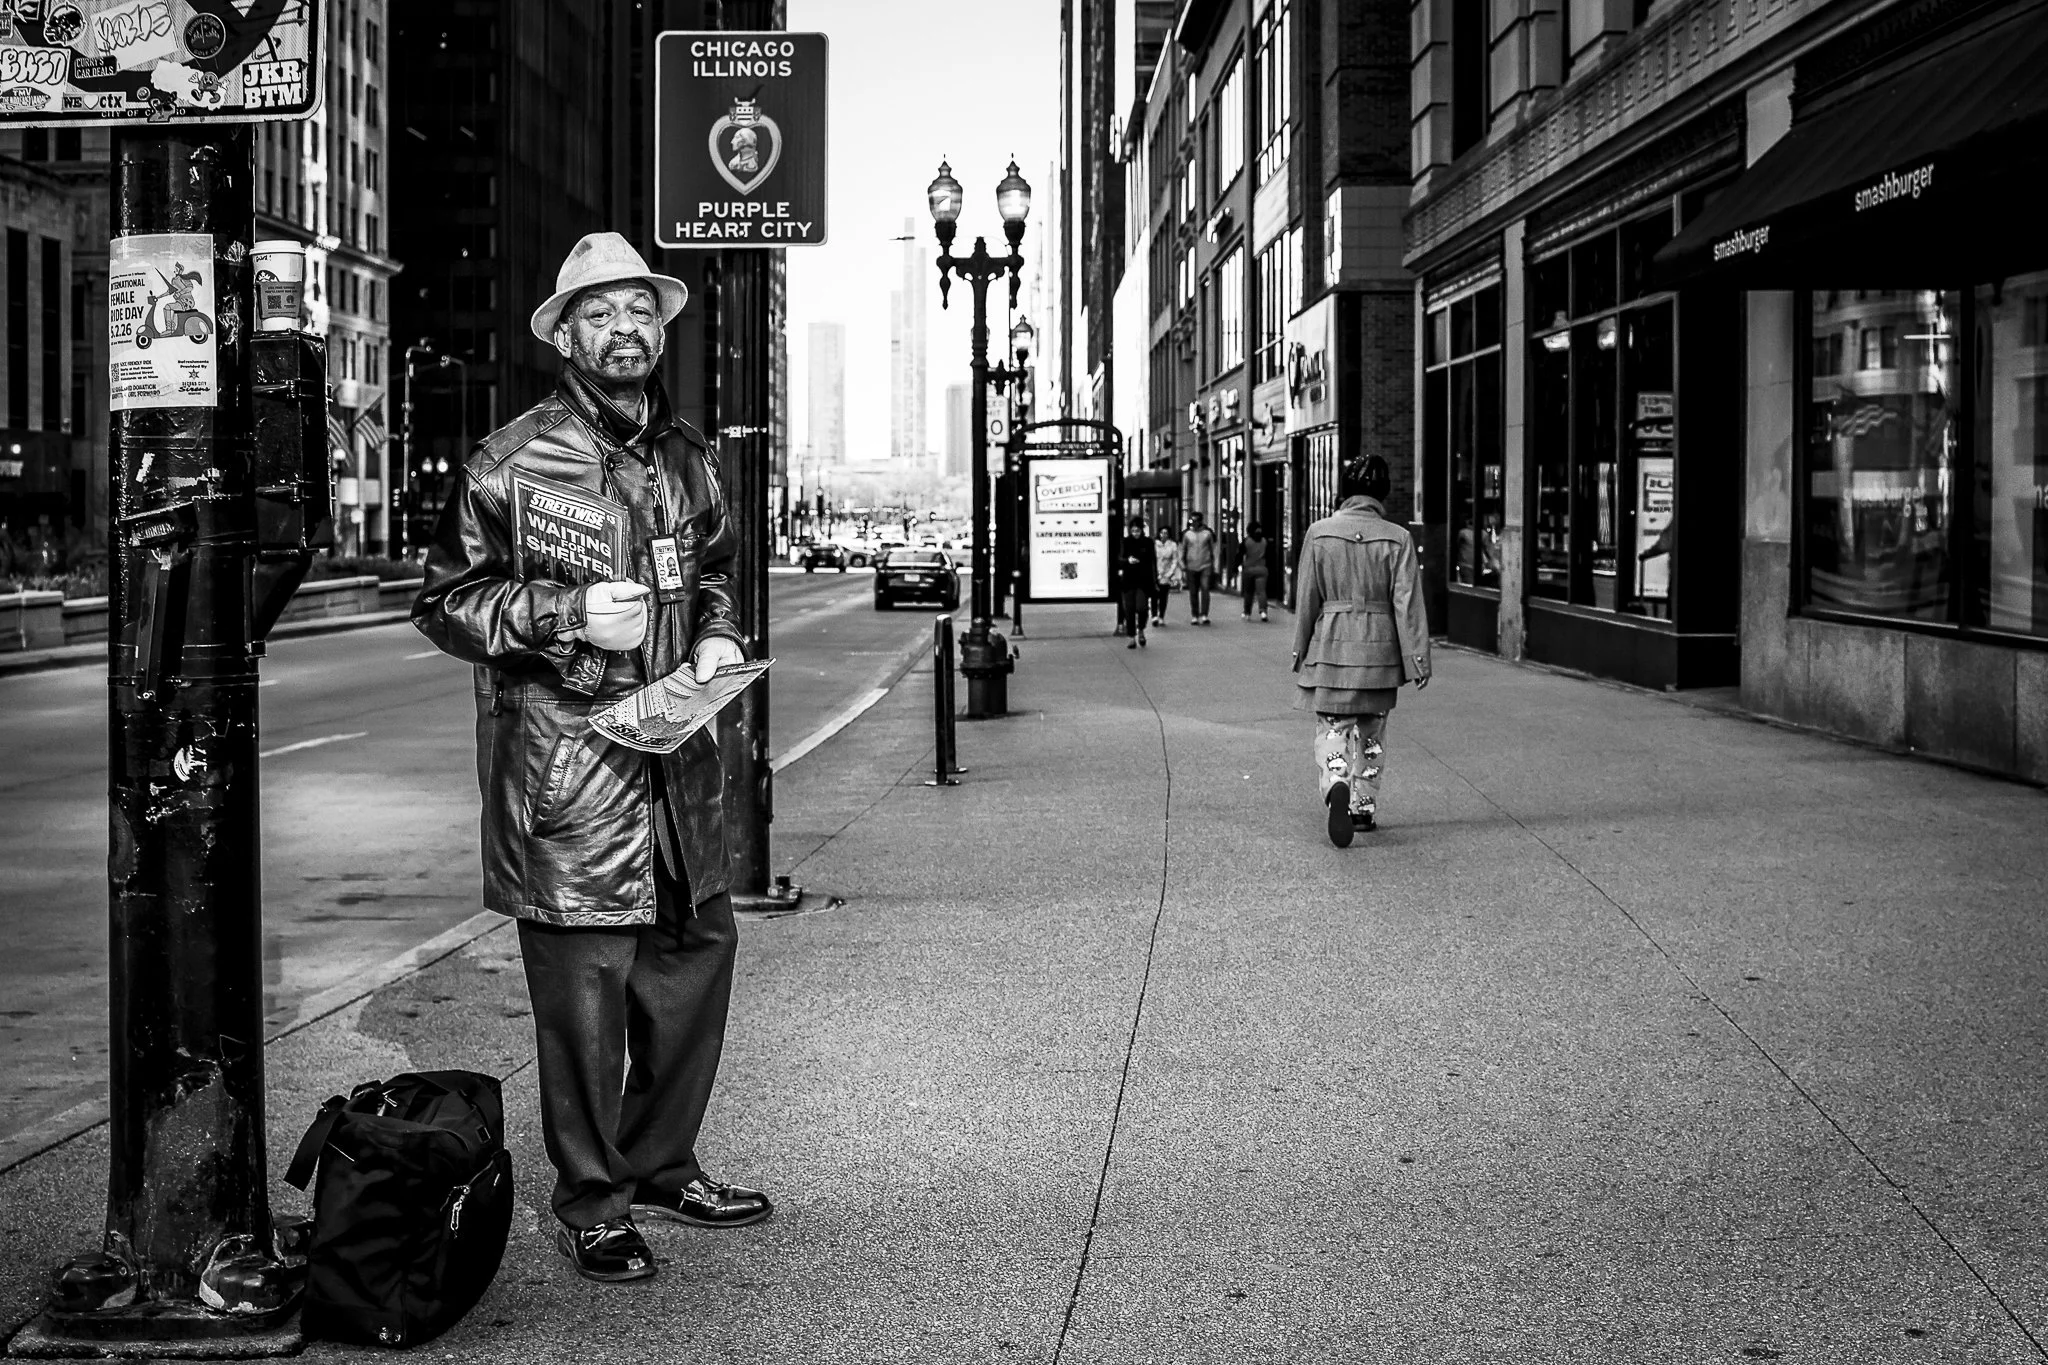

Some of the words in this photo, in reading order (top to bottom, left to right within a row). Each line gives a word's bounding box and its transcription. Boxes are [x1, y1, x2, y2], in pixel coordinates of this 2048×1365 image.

[691, 41, 795, 57] CHICAGO
[76, 68, 91, 78] CAR
[92, 66, 114, 77] DEALS
[244, 60, 302, 87] JKR
[693, 61, 792, 77] ILLINOIS
[244, 83, 302, 109] BTM
[127, 109, 139, 117] OF
[1855, 162, 1935, 212] smashburger
[698, 201, 790, 218] PURPLE
[675, 221, 752, 238] HEART
[761, 221, 812, 238] CITY
[1713, 225, 1770, 261] smashburger
[111, 291, 135, 307] FEMALE
[111, 308, 123, 322] RIDE
[125, 306, 144, 320] DAY
[1041, 482, 1096, 497] OVERDUE
[530, 493, 606, 528] STREETWISE
[526, 511, 612, 558] WAITING
[561, 538, 586, 555] FOR
[526, 534, 613, 580] SHELTER
